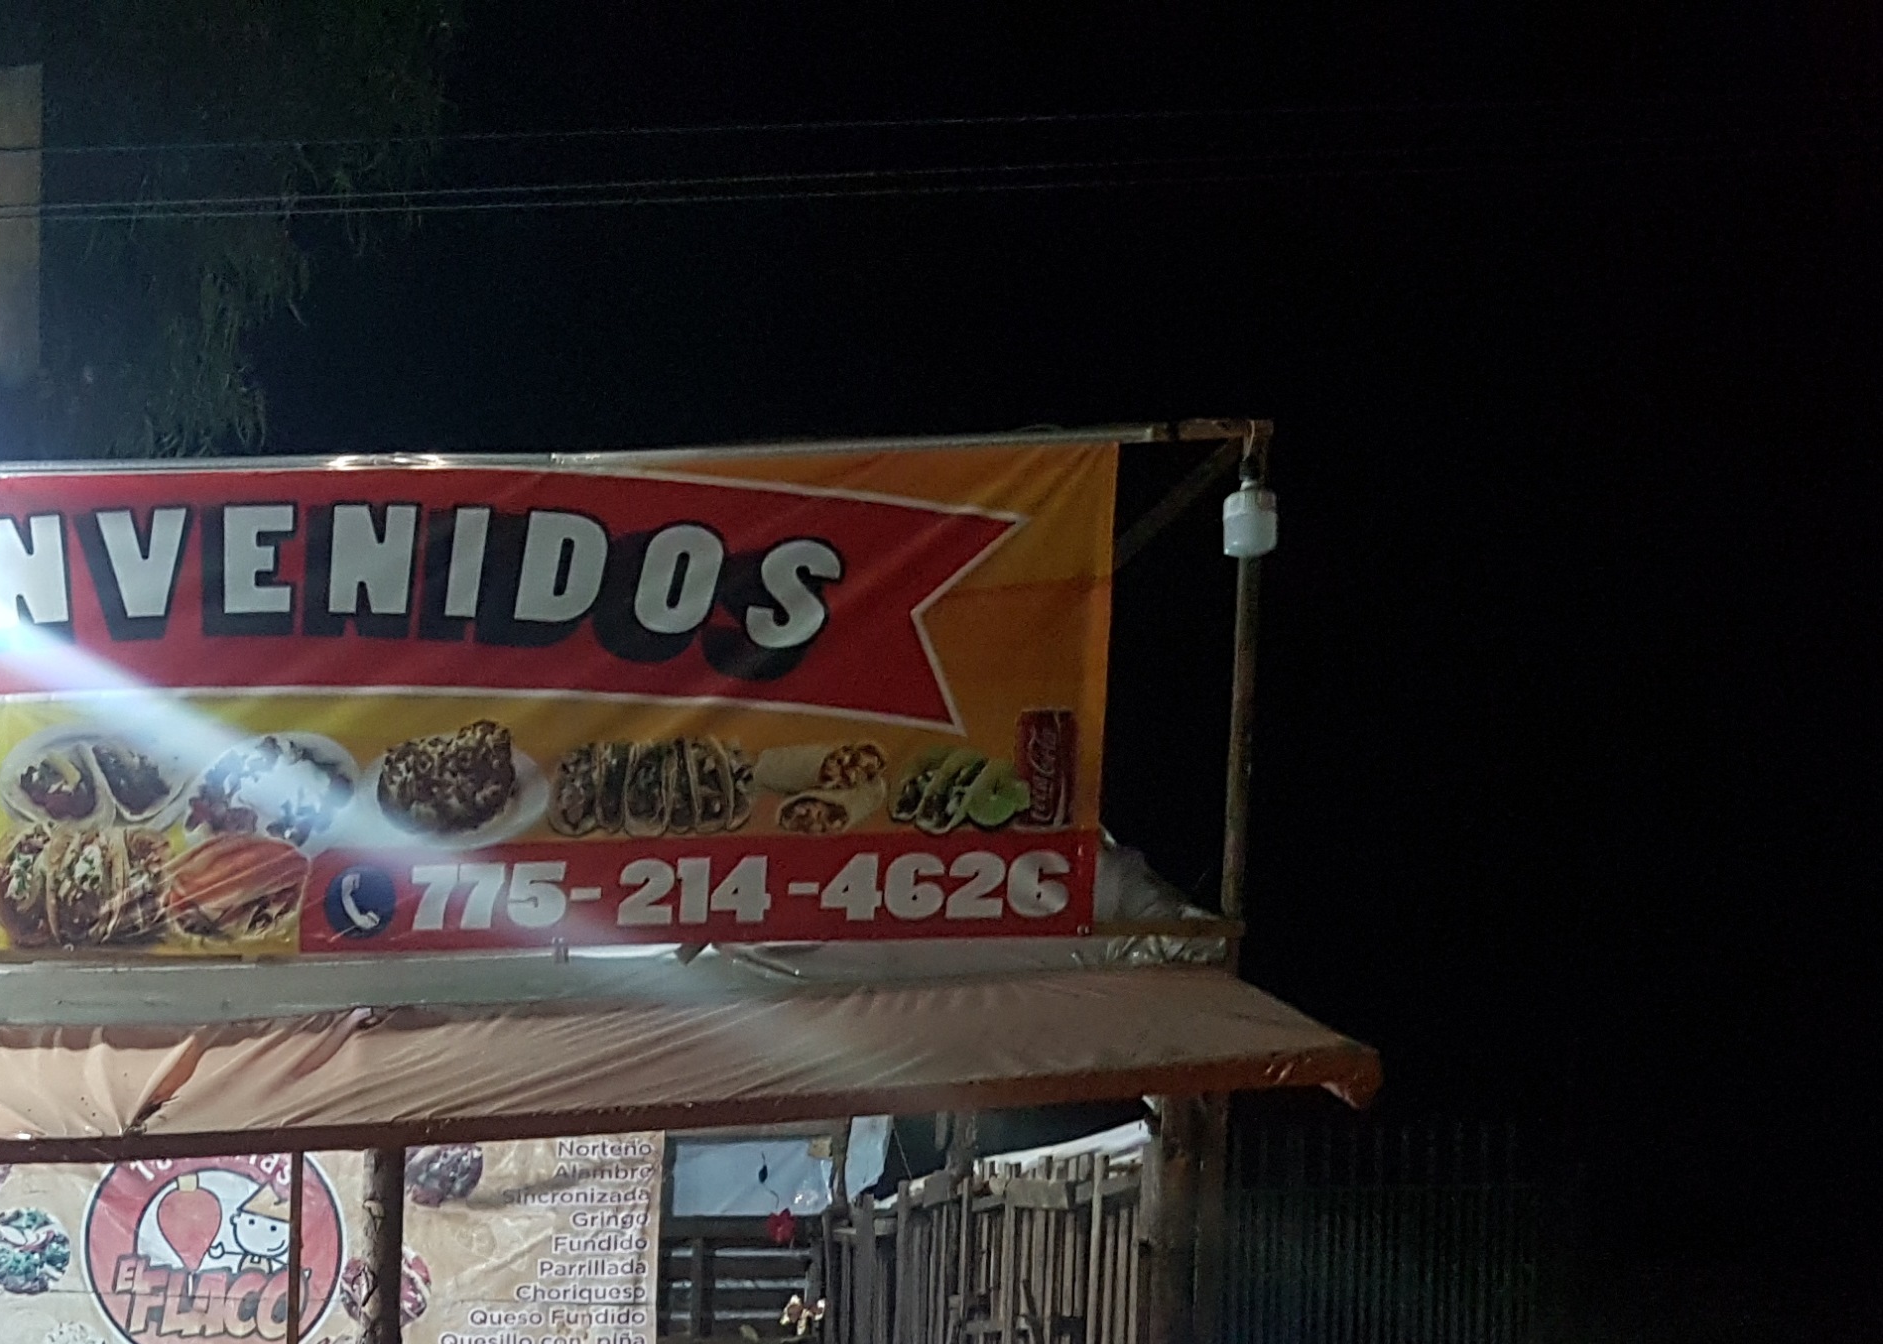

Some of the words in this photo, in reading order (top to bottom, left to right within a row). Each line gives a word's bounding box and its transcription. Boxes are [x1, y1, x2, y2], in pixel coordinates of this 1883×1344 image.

[553, 1236, 648, 1252] Fundido
[539, 1260, 647, 1277] Parrillada
[470, 1309, 543, 1327] Queso
[551, 1308, 646, 1325] Fundido
